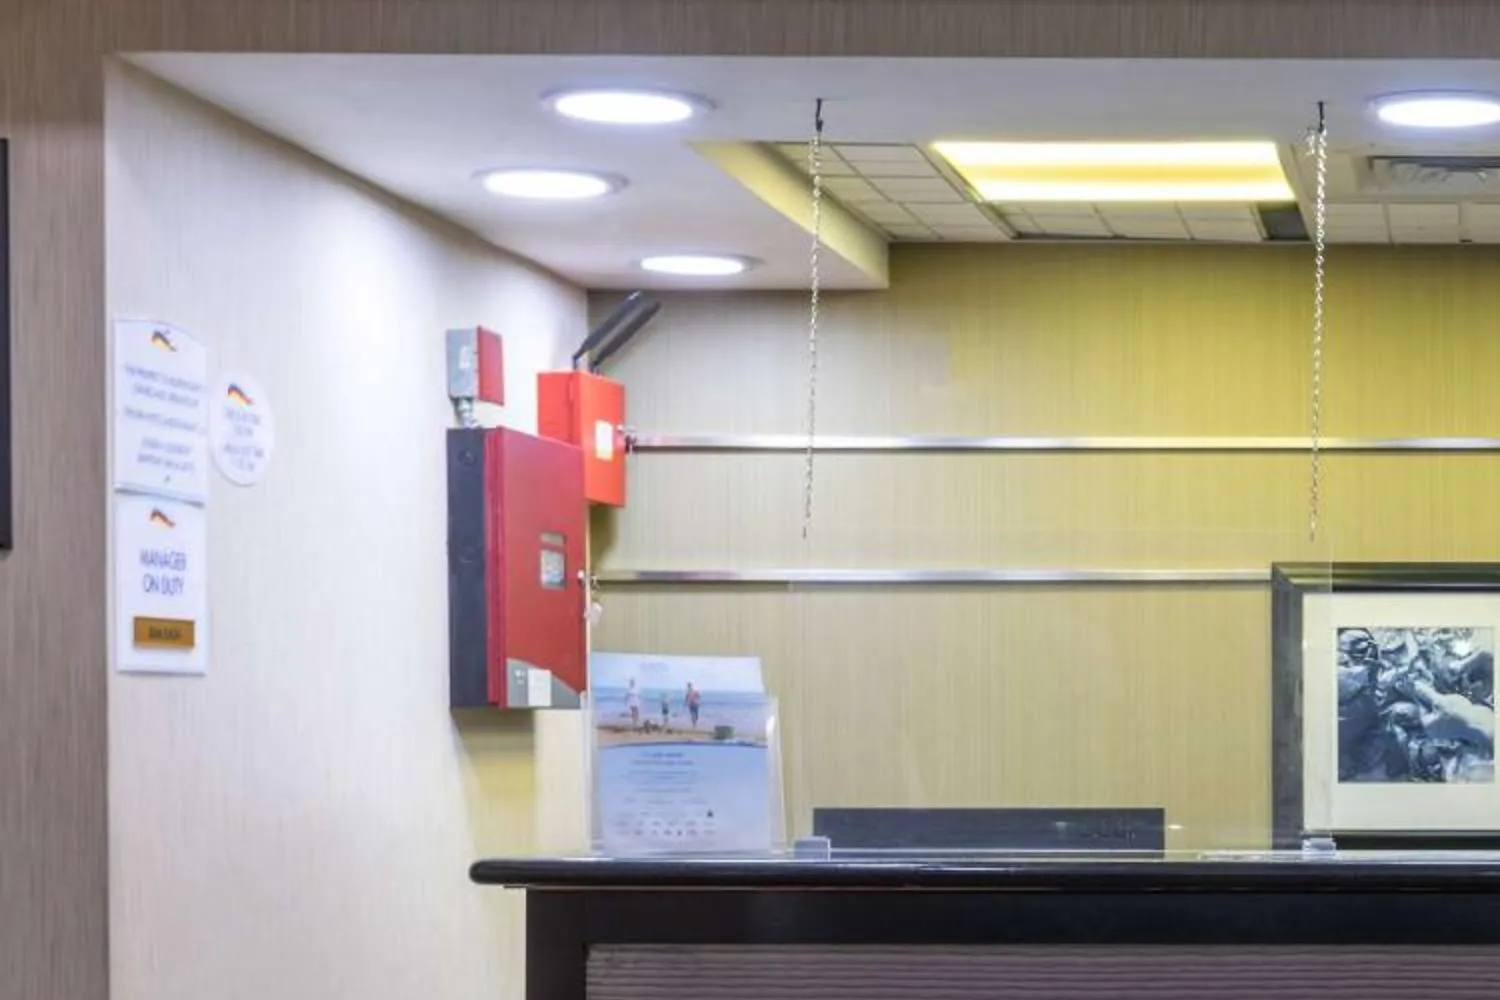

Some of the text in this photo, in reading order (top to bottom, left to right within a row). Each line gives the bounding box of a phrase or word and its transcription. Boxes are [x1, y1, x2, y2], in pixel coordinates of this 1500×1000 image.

[140, 549, 186, 571] MANAGER
[142, 573, 184, 595] ON DUTY
